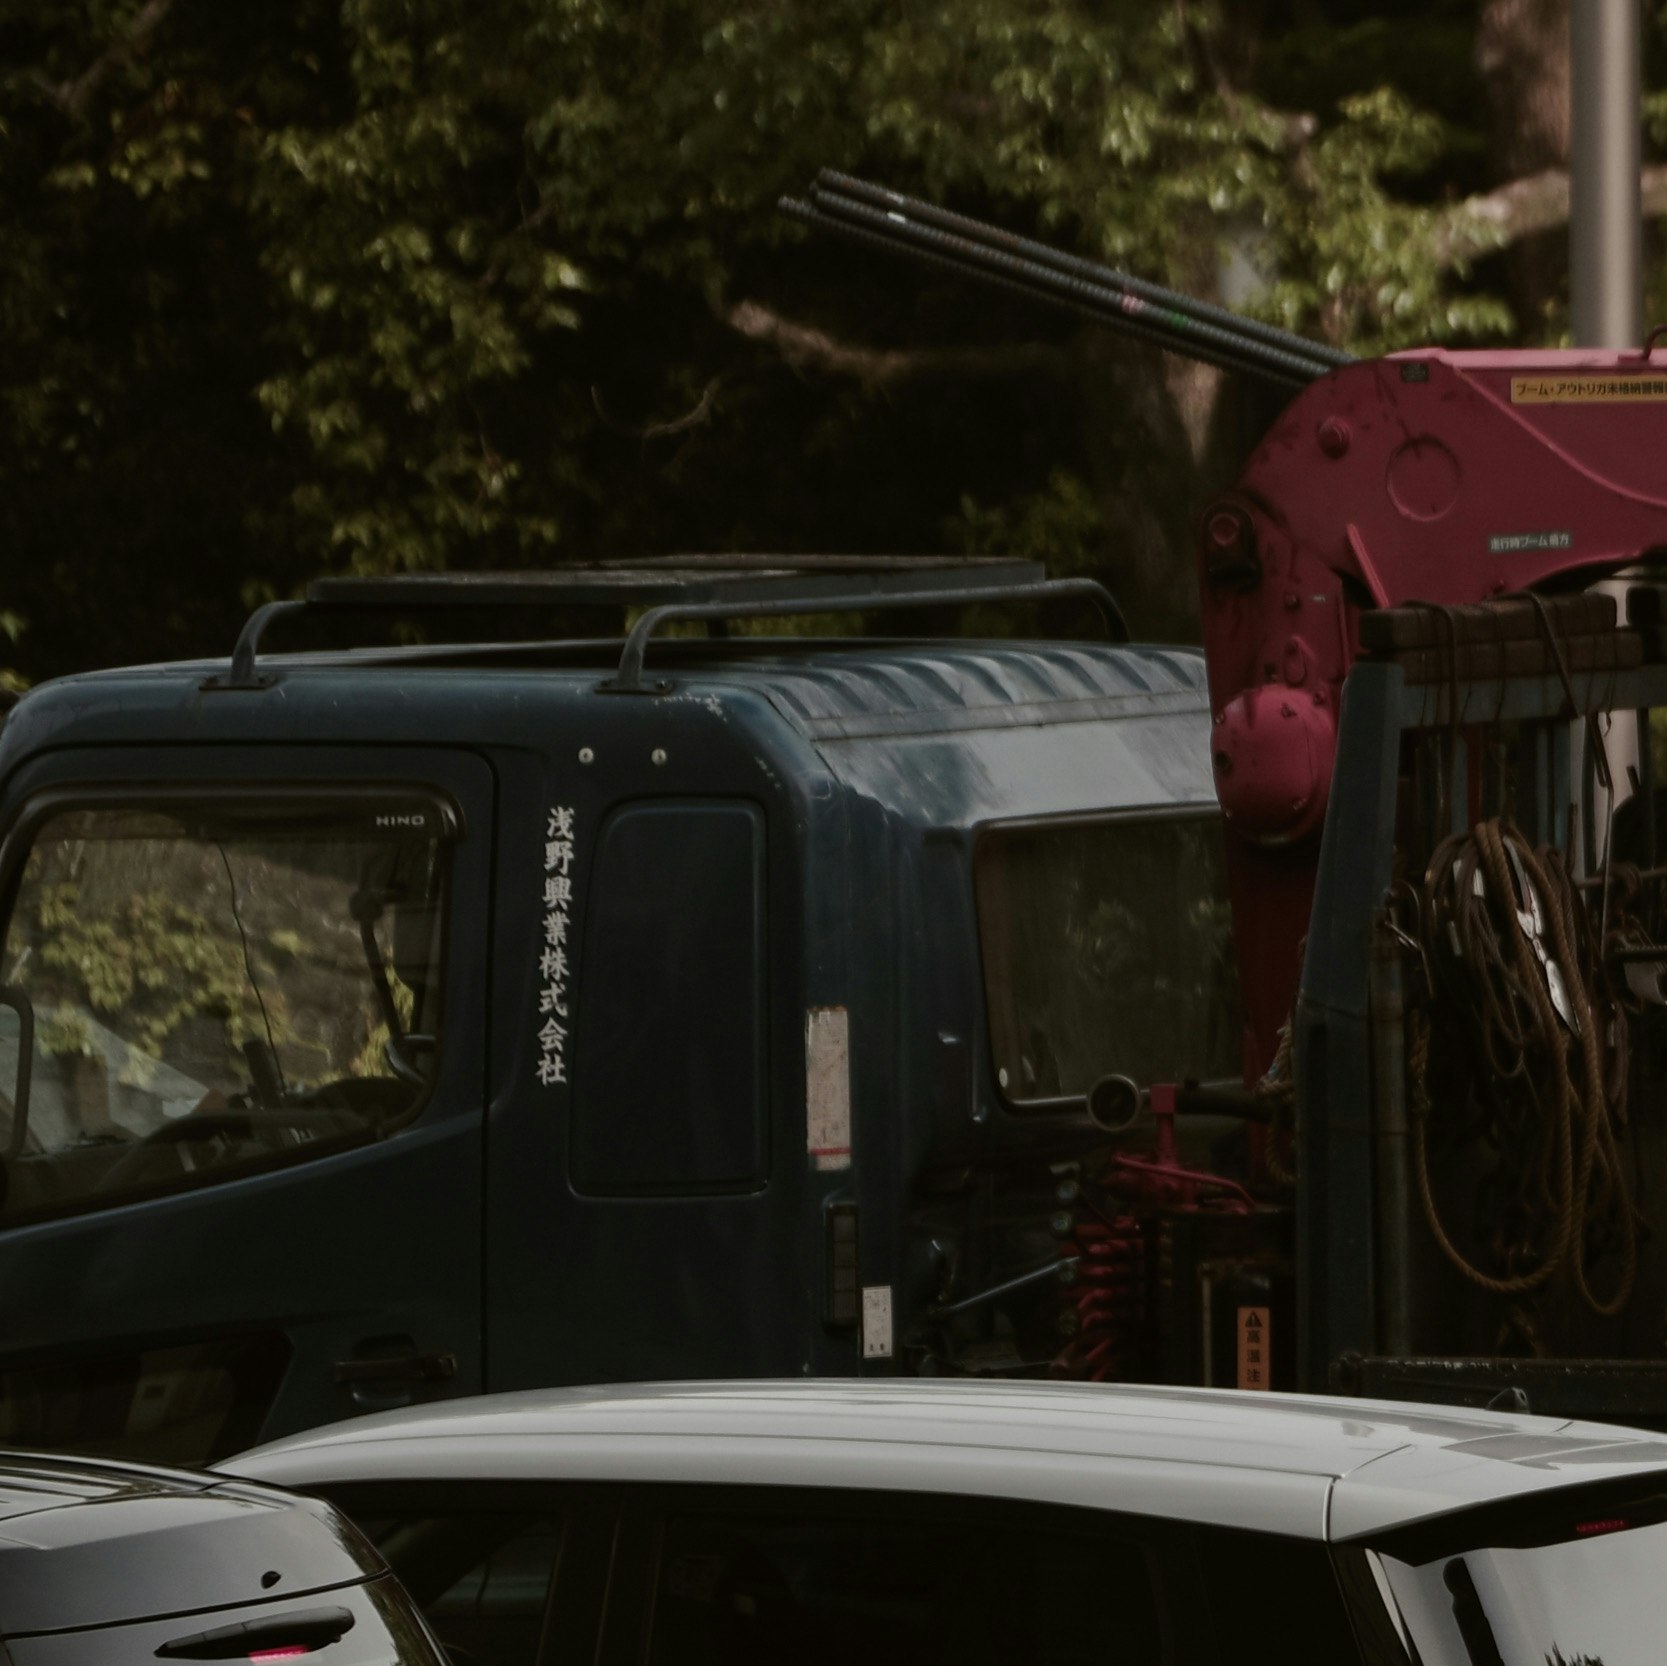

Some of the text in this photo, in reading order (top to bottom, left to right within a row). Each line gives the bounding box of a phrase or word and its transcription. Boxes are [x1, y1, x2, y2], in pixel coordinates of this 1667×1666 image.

[375, 814, 426, 827] HINO
[535, 804, 576, 1088] 浅野興業株式会社
